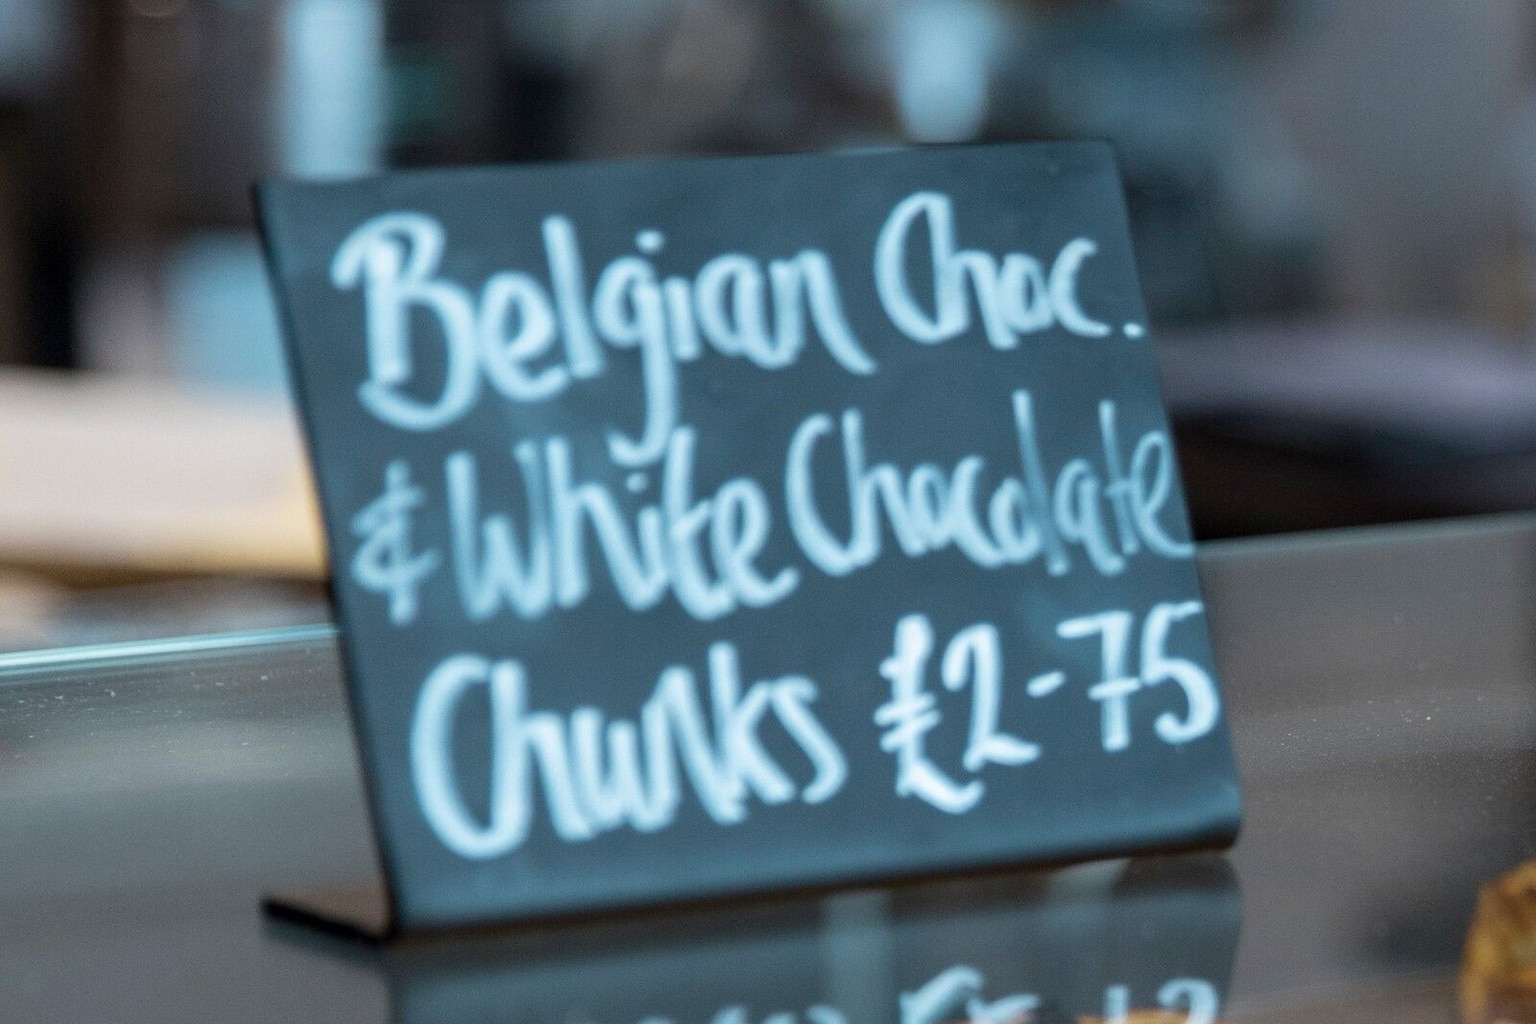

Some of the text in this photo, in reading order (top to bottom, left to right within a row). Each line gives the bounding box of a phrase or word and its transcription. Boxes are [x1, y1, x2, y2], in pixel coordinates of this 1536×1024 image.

[330, 191, 1144, 467] Belgian Choc.
[445, 427, 801, 619] White
[786, 390, 1195, 575] Chocolate
[411, 601, 1221, 859] Chunks £2-75
